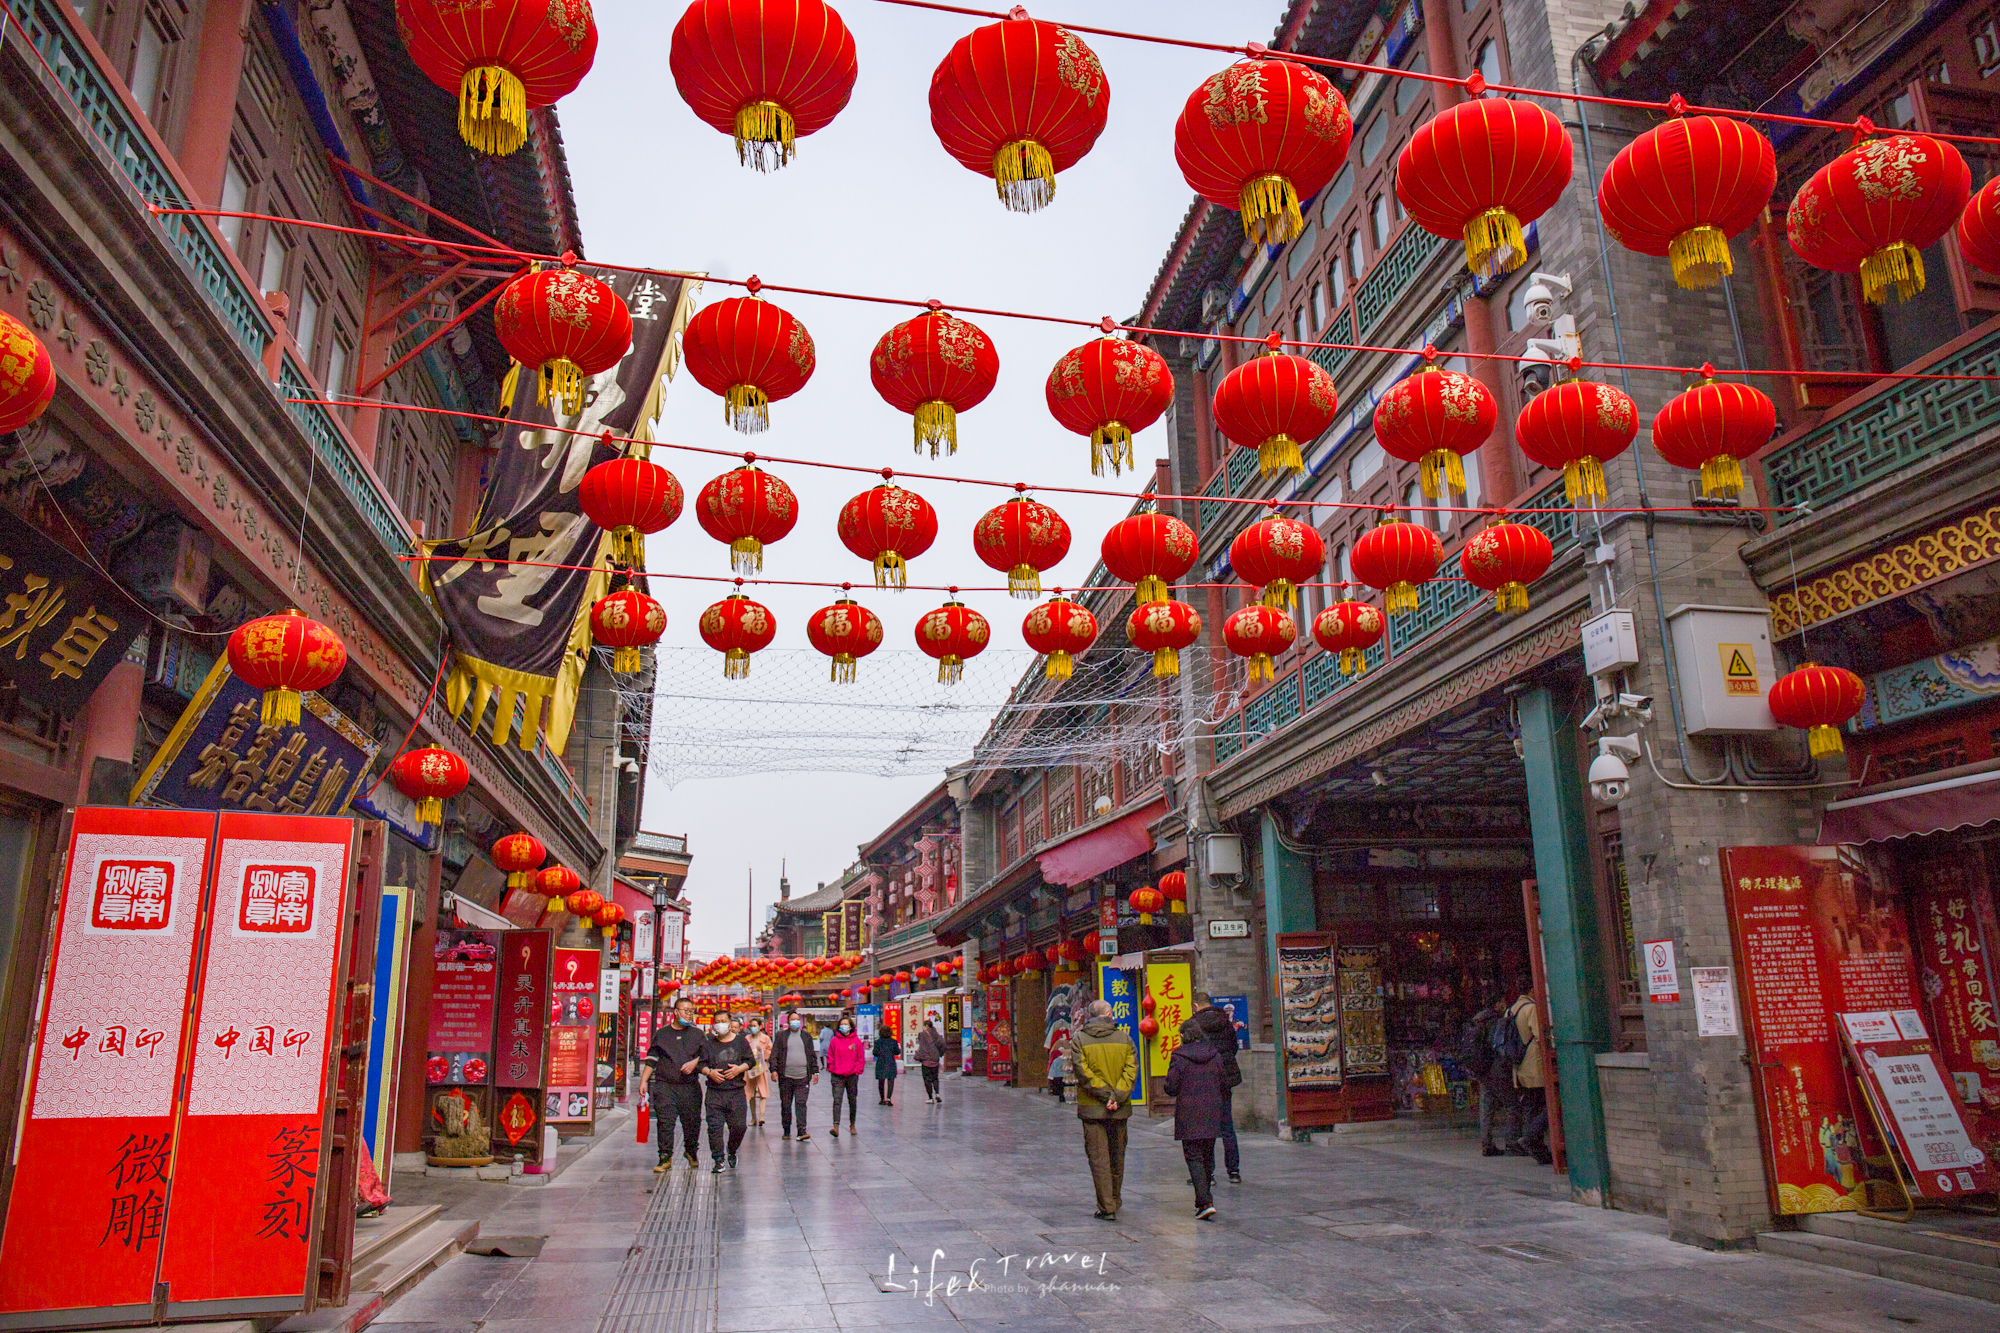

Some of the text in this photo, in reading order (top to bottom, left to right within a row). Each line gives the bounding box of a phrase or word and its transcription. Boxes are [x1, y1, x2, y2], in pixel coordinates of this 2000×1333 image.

[1852, 139, 1927, 202] 吉祥如意
[545, 272, 600, 330] 吉祥如意
[601, 600, 629, 629] 福
[702, 605, 725, 634] 福
[740, 604, 768, 635] 福
[820, 609, 852, 637] 福
[923, 612, 951, 641] 福
[967, 613, 988, 643] 福
[1026, 608, 1051, 634] 福
[1068, 609, 1093, 638] 福
[1145, 606, 1175, 633] 福
[1234, 611, 1263, 639] 福
[1318, 610, 1344, 637] 福
[1356, 607, 1382, 634] 福
[1739, 875, 1803, 891] 狗不理起源
[1223, 923, 1244, 931] 卫生间
[1652, 974, 1673, 983] 无烟景区
[509, 974, 534, 1081] 灵丹真朱砂
[909, 1004, 918, 1031] 筷子
[62, 1025, 165, 1061] 中国印
[214, 1025, 311, 1060] 中国印
[1888, 1063, 1921, 1074] 文明节俭
[1892, 1074, 1927, 1086] 就餐公约
[509, 1103, 527, 1129] 福
[98, 1132, 172, 1253] 微雕
[254, 1124, 321, 1244] 篆刻
